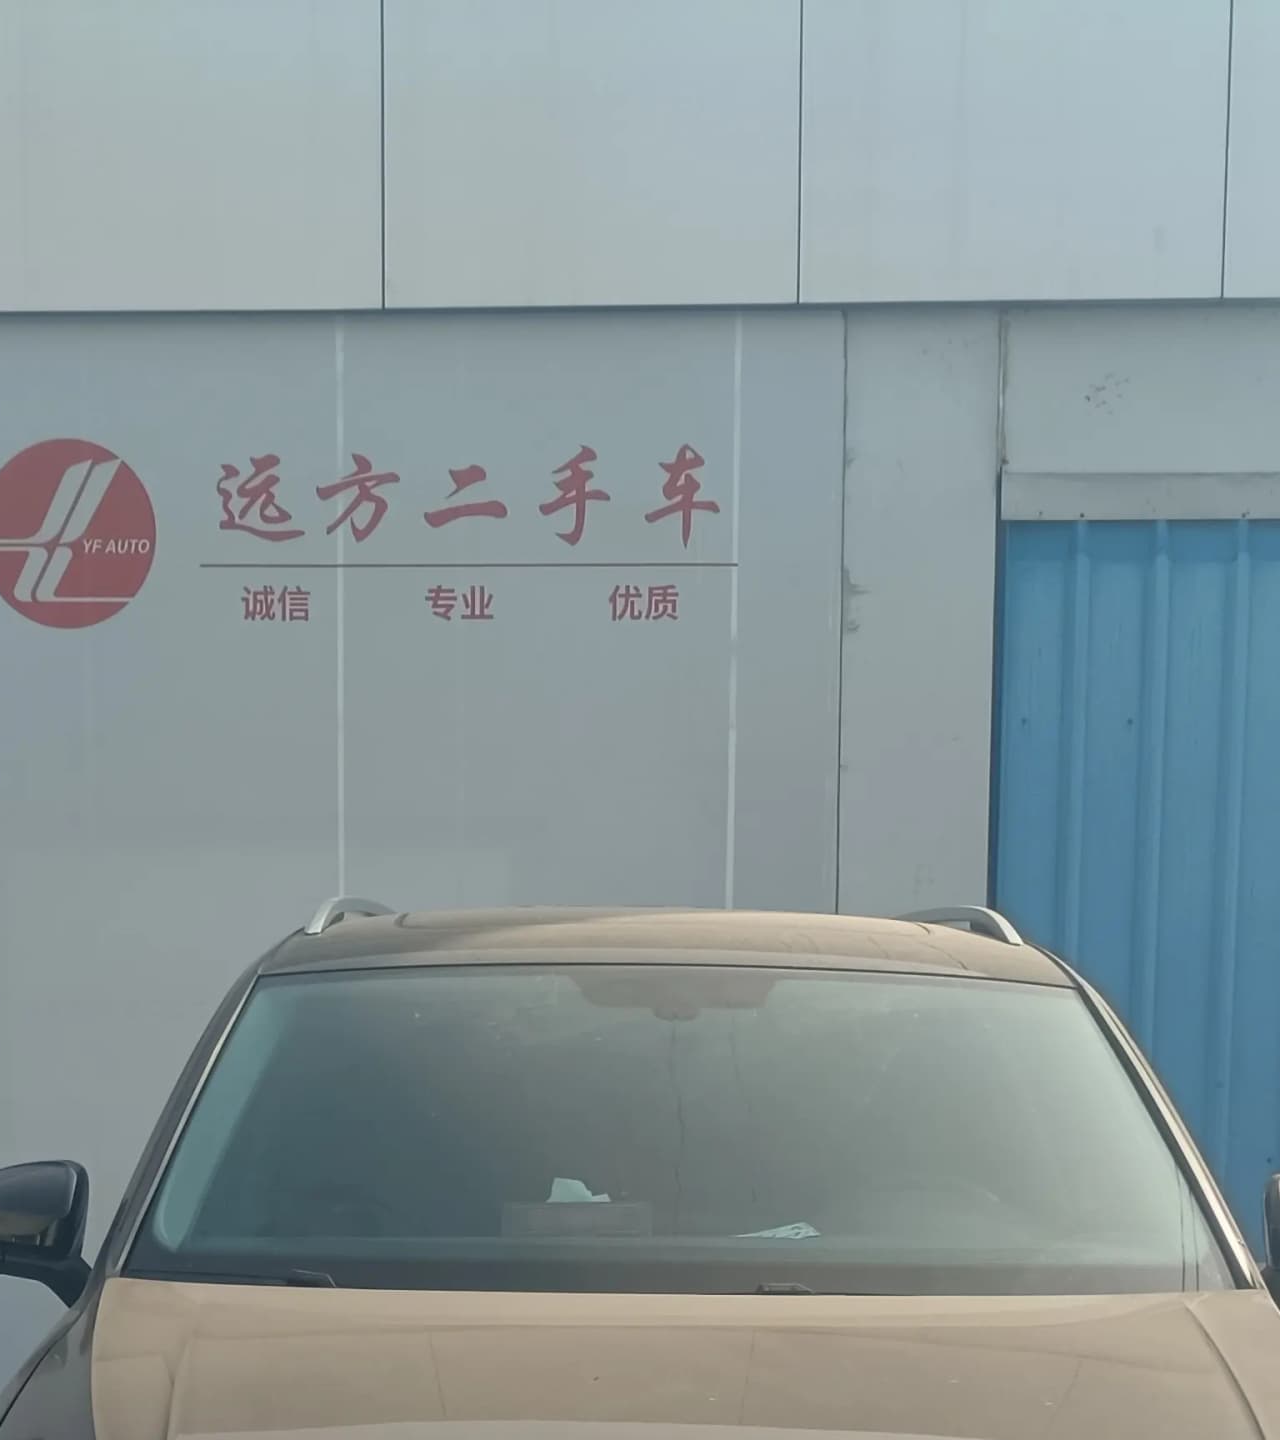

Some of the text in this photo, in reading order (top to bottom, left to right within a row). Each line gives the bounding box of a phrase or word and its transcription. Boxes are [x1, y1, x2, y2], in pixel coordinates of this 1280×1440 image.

[216, 444, 721, 549] 远方二手车
[82, 538, 150, 555] YF AUTO
[241, 584, 680, 622] 诚信 专业 优质
